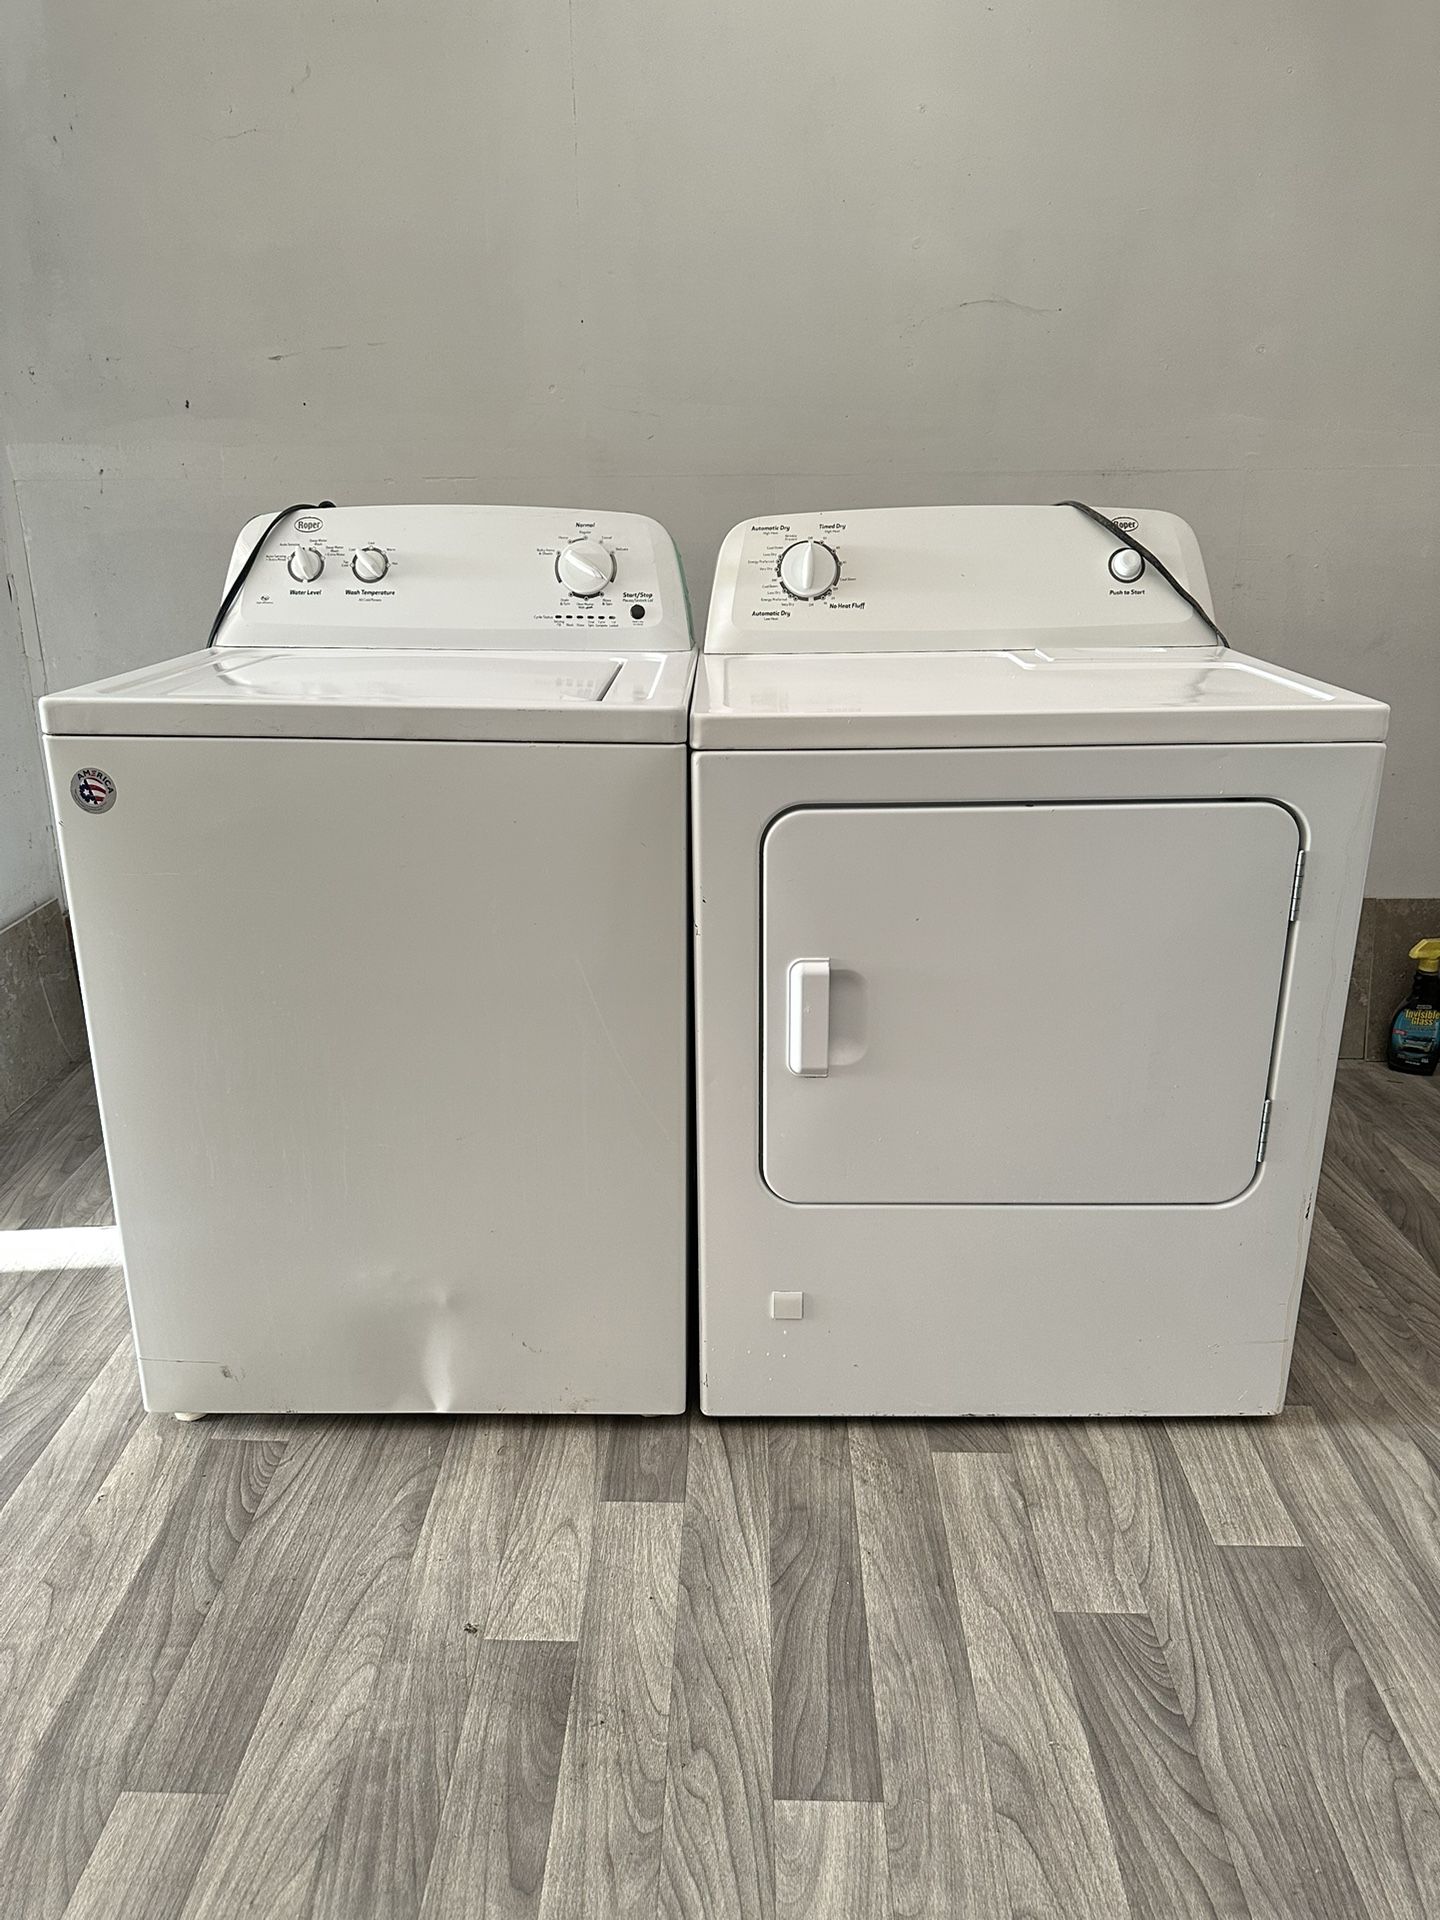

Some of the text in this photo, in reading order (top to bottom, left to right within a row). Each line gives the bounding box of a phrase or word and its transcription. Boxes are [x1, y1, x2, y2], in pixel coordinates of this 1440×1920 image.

[298, 520, 321, 530] Roper
[78, 770, 114, 793] AMERICA
[1405, 1008, 1440, 1020] Invisible
